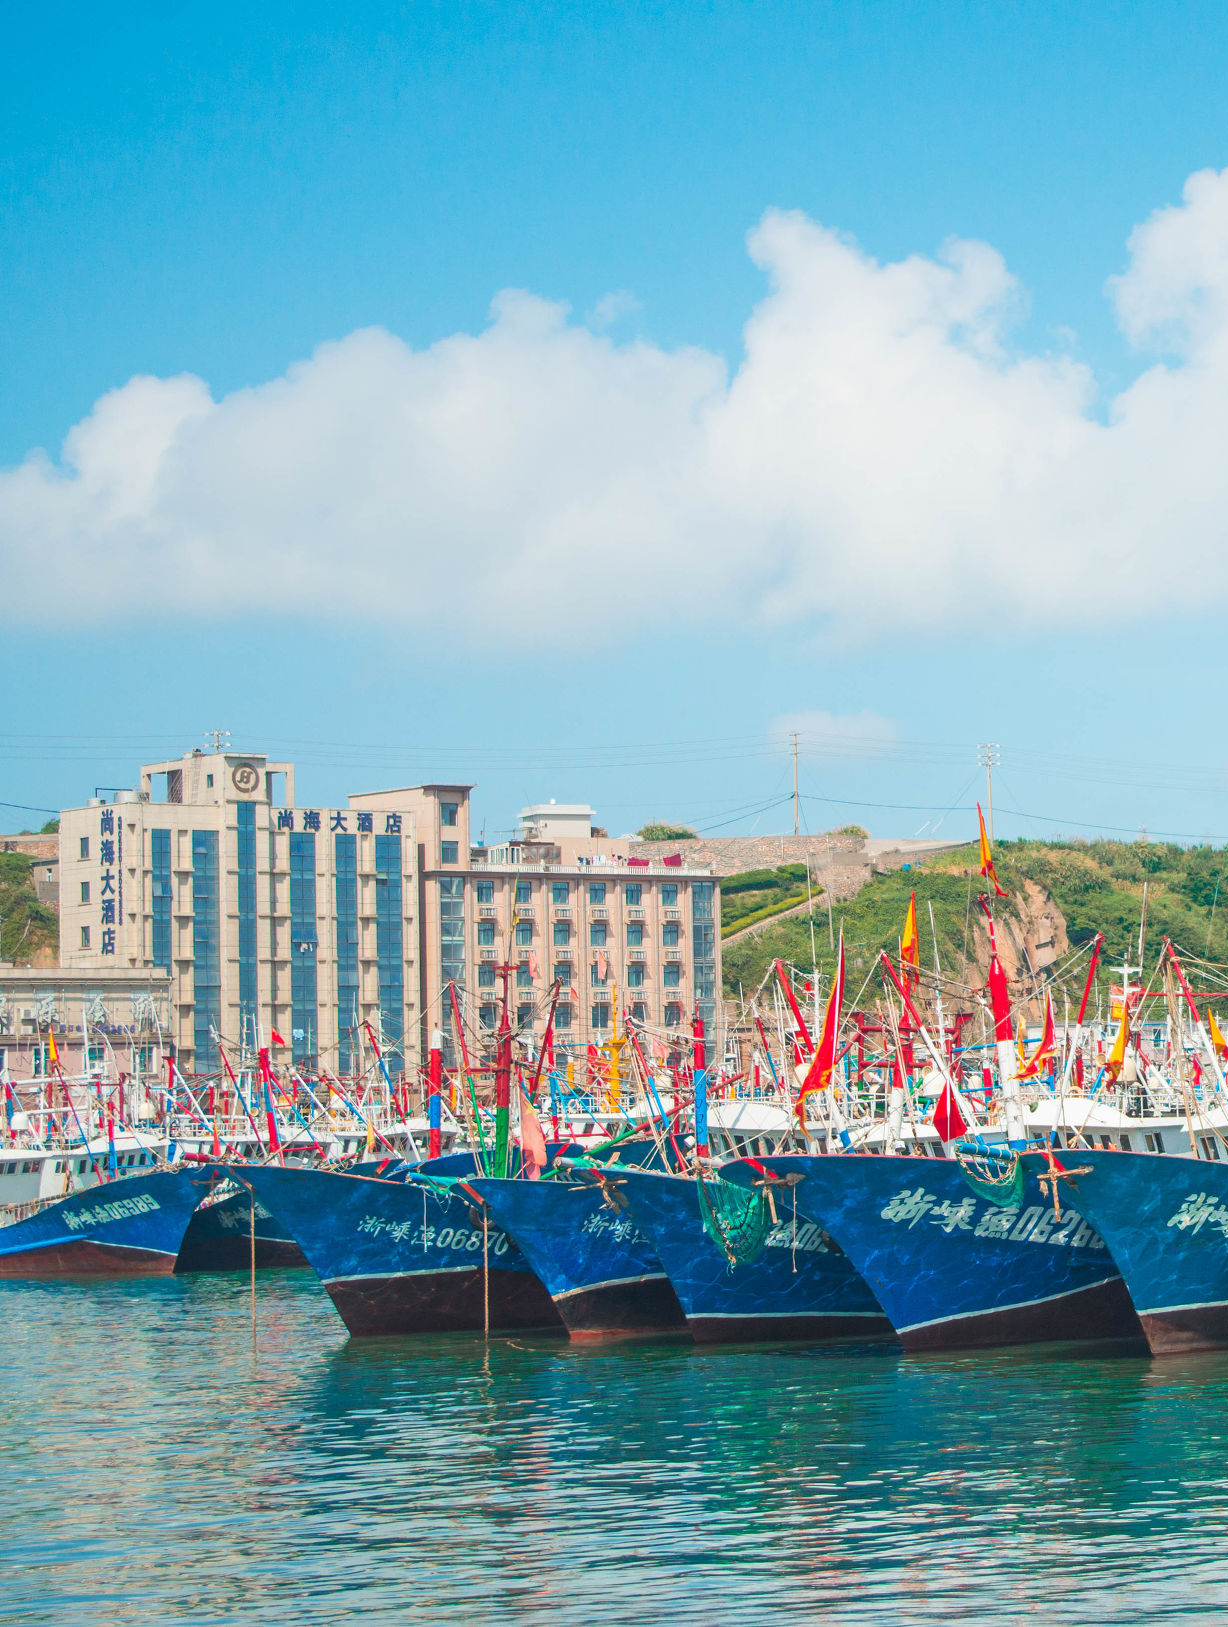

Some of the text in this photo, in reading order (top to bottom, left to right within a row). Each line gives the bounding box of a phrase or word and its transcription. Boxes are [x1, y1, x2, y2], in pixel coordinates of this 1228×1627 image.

[277, 809, 402, 833] 尚海大酒店
[100, 808, 116, 956] 尚海大酒店
